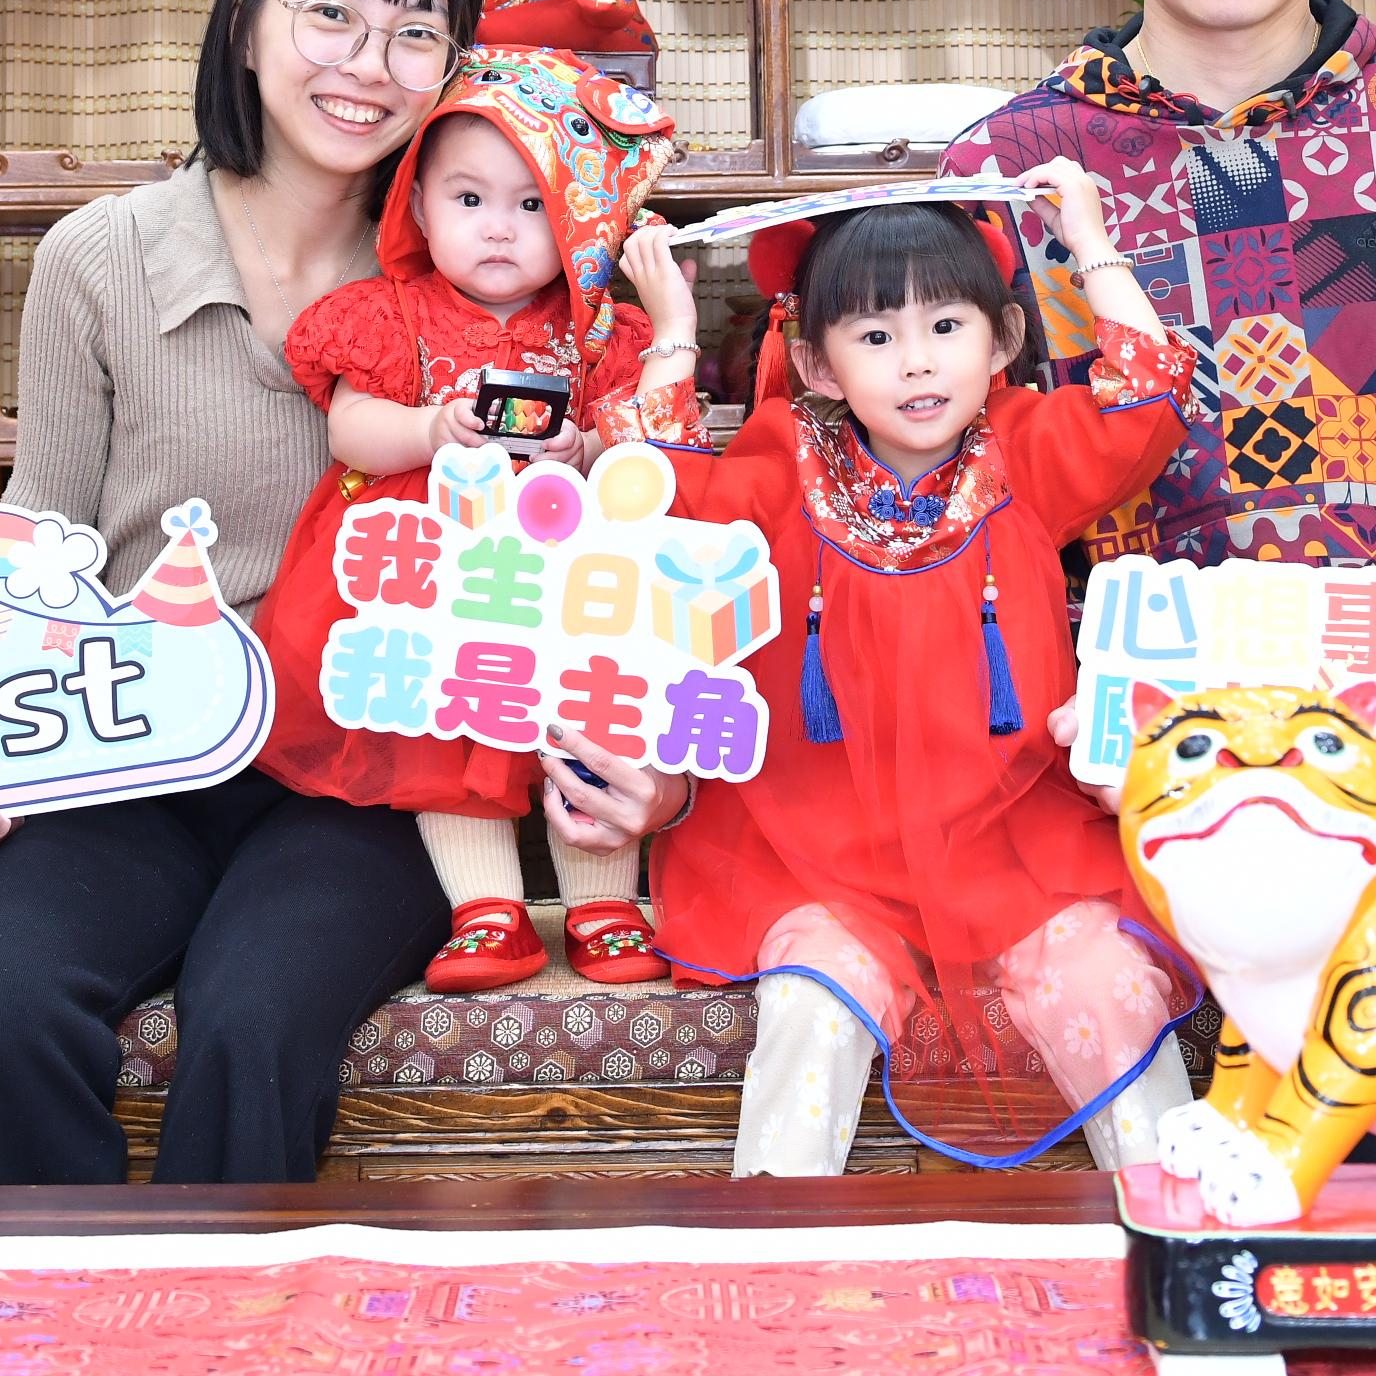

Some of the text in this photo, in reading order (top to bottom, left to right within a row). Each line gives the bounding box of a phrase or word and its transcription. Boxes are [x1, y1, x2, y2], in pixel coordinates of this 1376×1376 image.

[342, 512, 640, 637] 我生日
[328, 625, 761, 773] 我是主角
